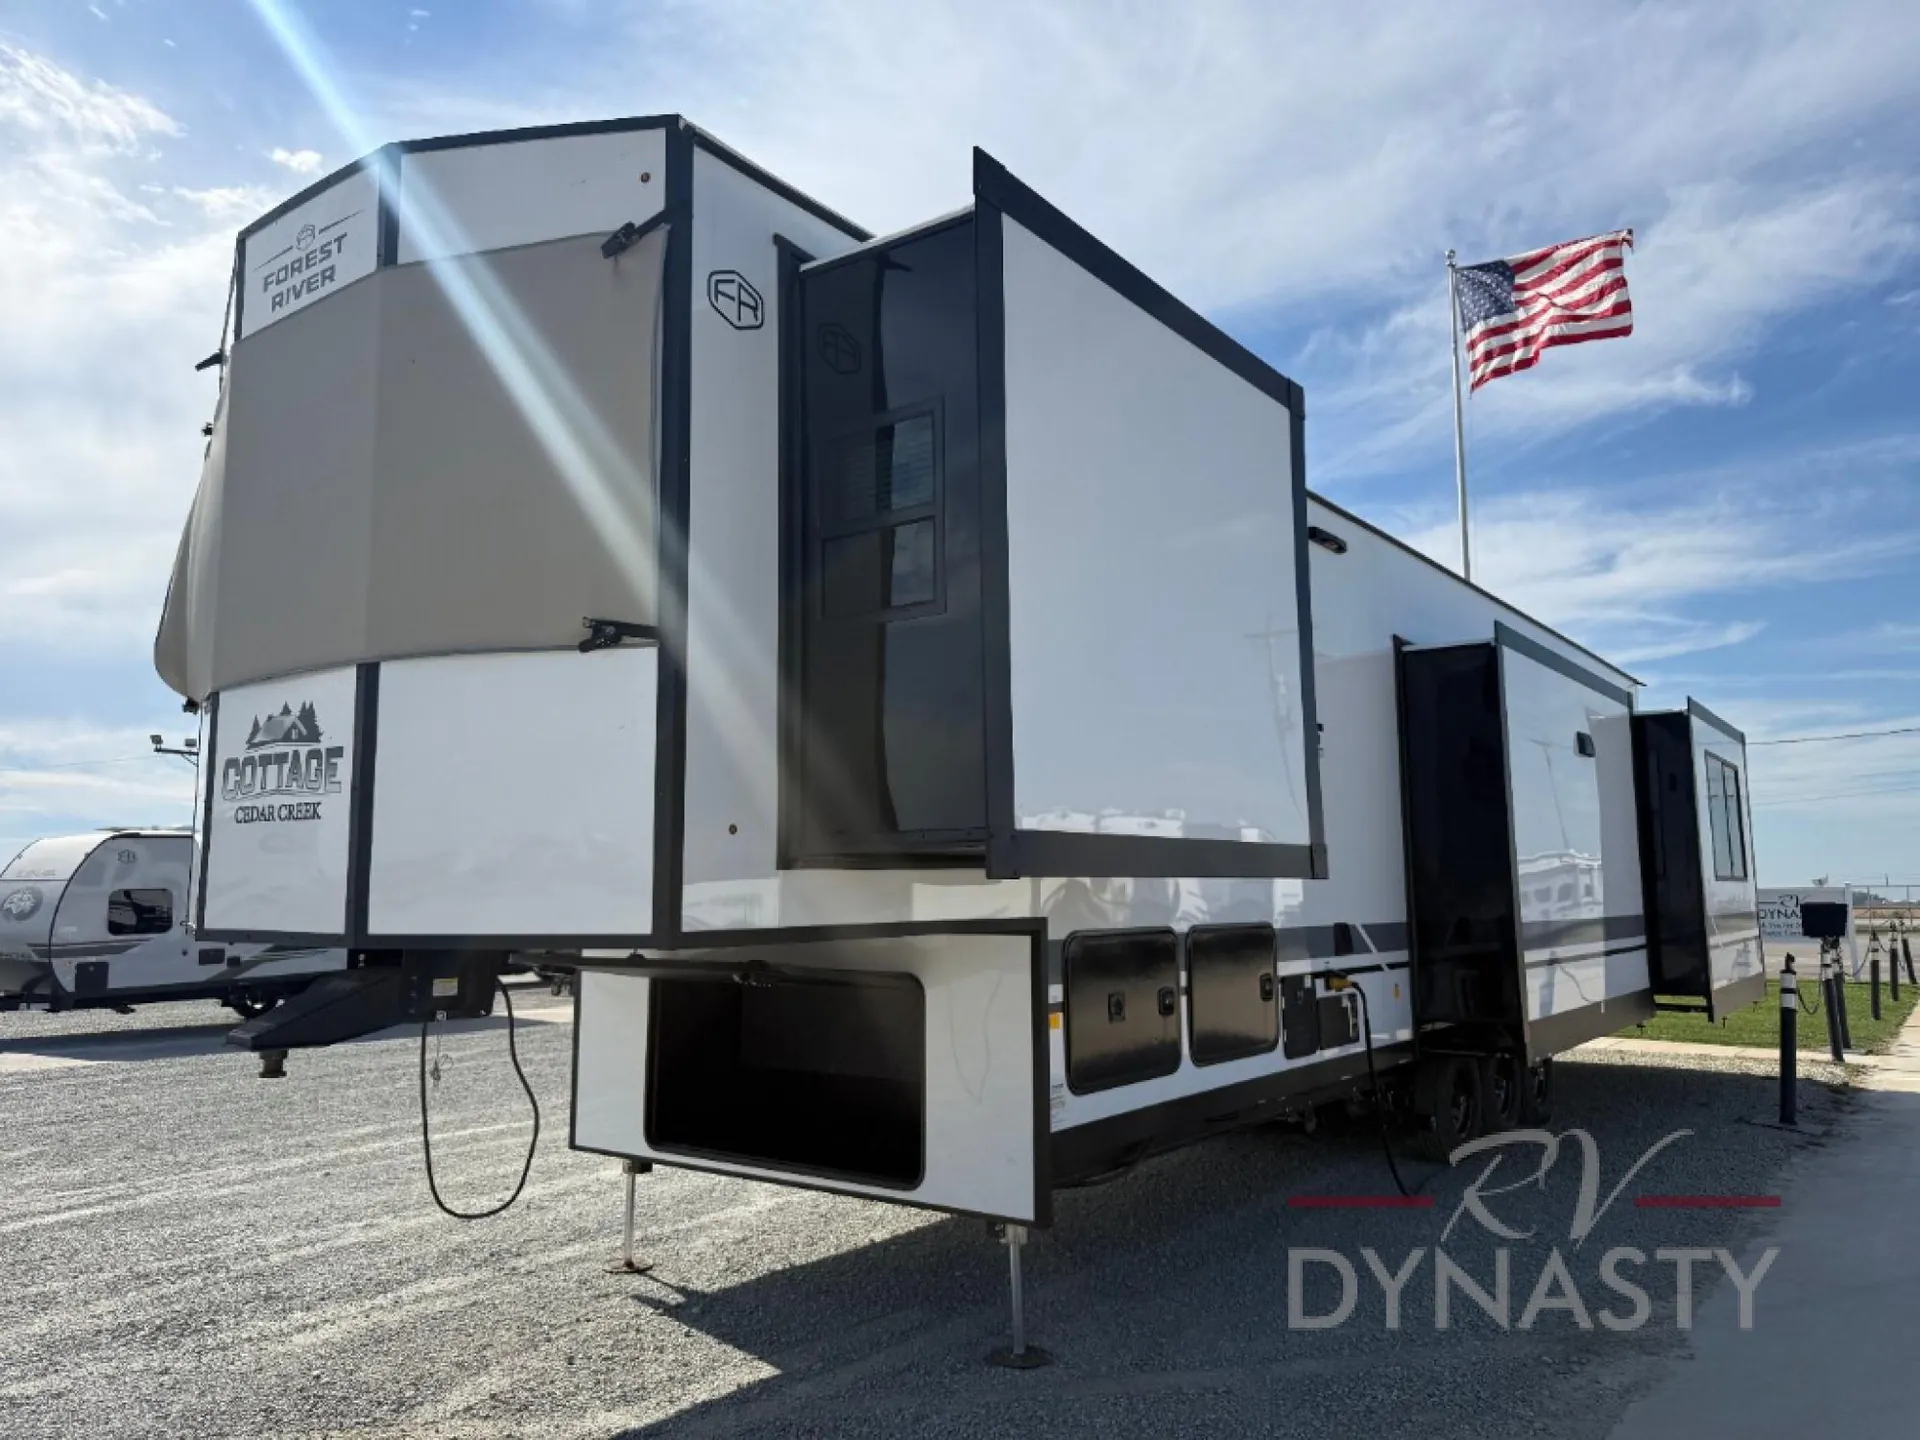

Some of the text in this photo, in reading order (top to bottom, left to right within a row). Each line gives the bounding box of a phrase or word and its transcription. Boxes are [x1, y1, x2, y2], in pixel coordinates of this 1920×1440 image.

[262, 232, 348, 293] FOREST
[271, 264, 336, 313] RIVER
[222, 746, 344, 801] COTTAGE
[235, 802, 322, 824] CEDAR CREEK
[1759, 907, 1801, 920] DYNA
